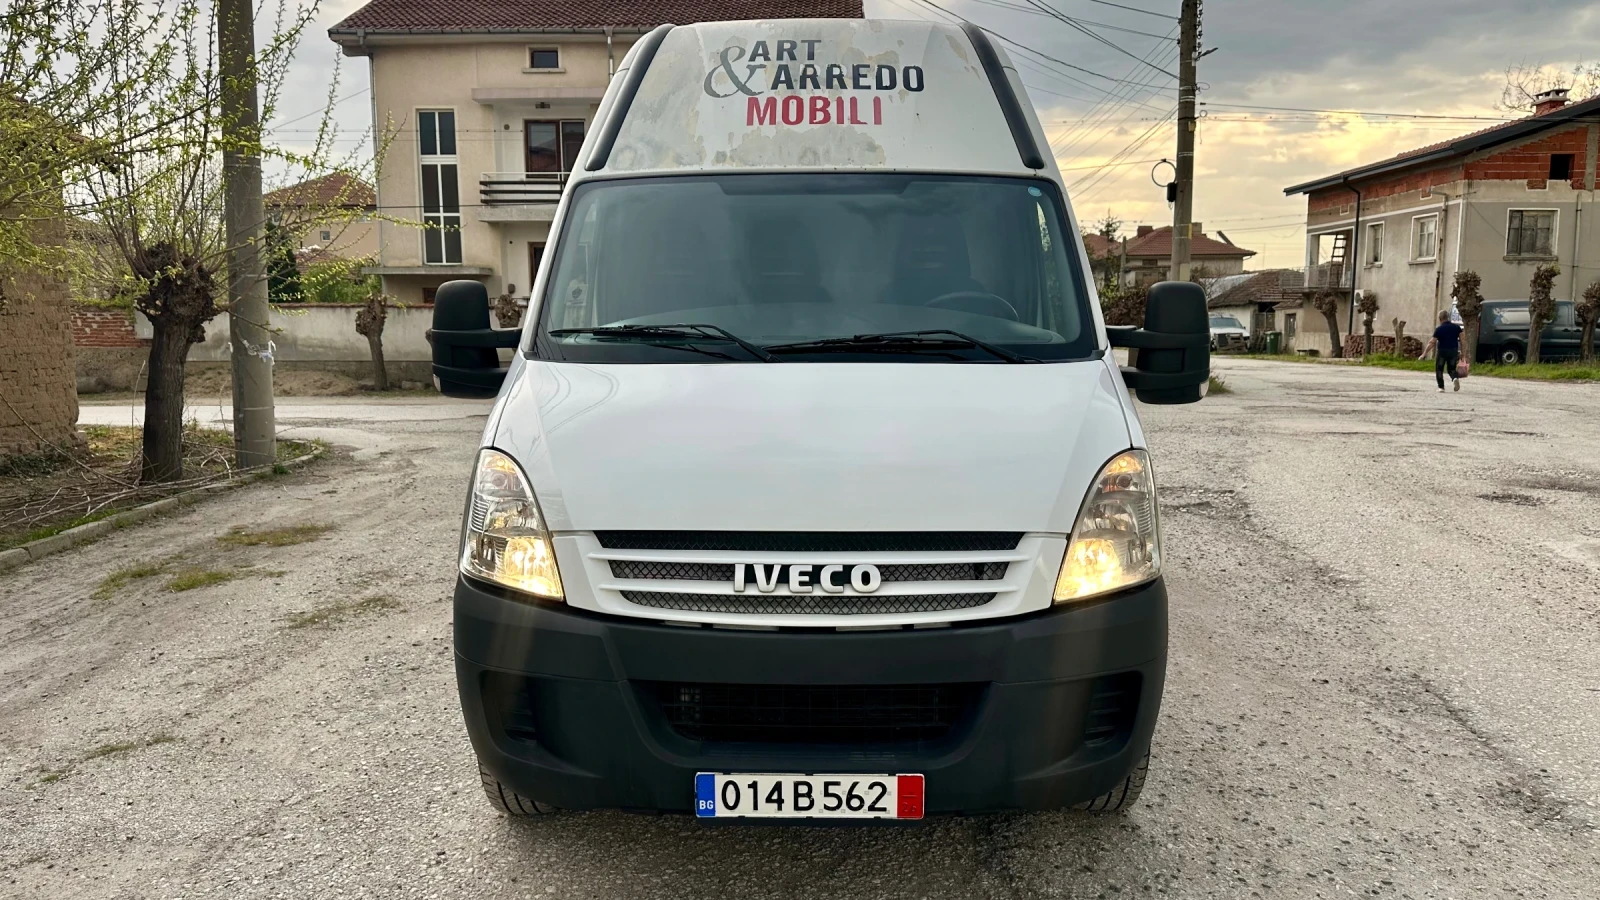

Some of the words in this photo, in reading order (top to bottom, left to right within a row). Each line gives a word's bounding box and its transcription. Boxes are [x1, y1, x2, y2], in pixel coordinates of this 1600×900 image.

[748, 40, 822, 62] ART
[704, 46, 767, 98] &
[771, 63, 925, 92] ARREDO
[746, 95, 882, 126] MOBILI
[733, 563, 882, 593] IVECO
[700, 800, 714, 810] BG
[721, 780, 888, 812] 014B562
